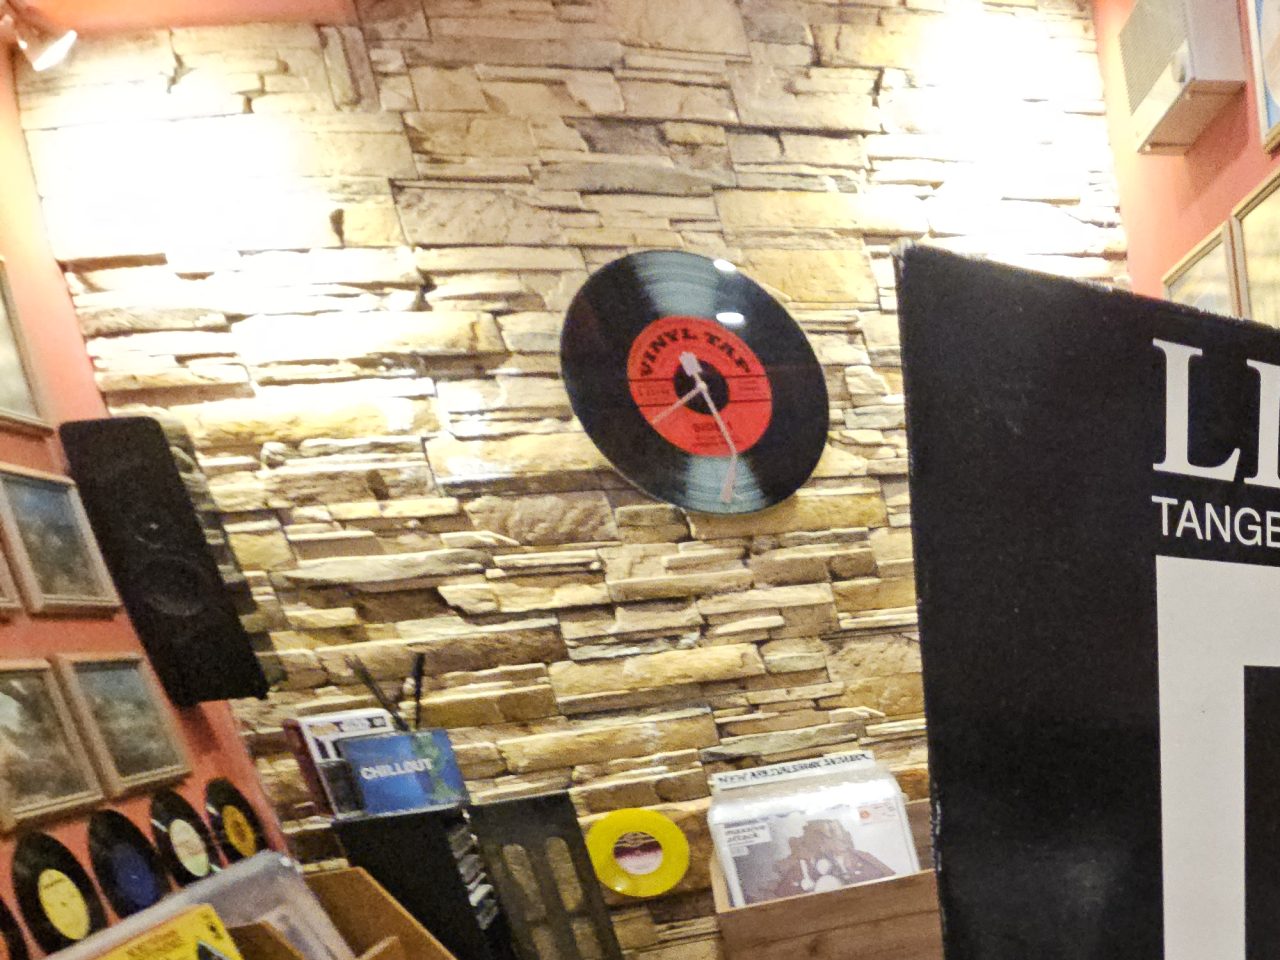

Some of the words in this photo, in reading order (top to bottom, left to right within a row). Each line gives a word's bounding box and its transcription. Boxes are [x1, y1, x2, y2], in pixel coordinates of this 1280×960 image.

[640, 328, 698, 376] VINYL
[704, 331, 750, 373] TAP
[360, 758, 433, 780] CHILLOUT
[724, 824, 766, 836] massive
[726, 832, 760, 844] attack
